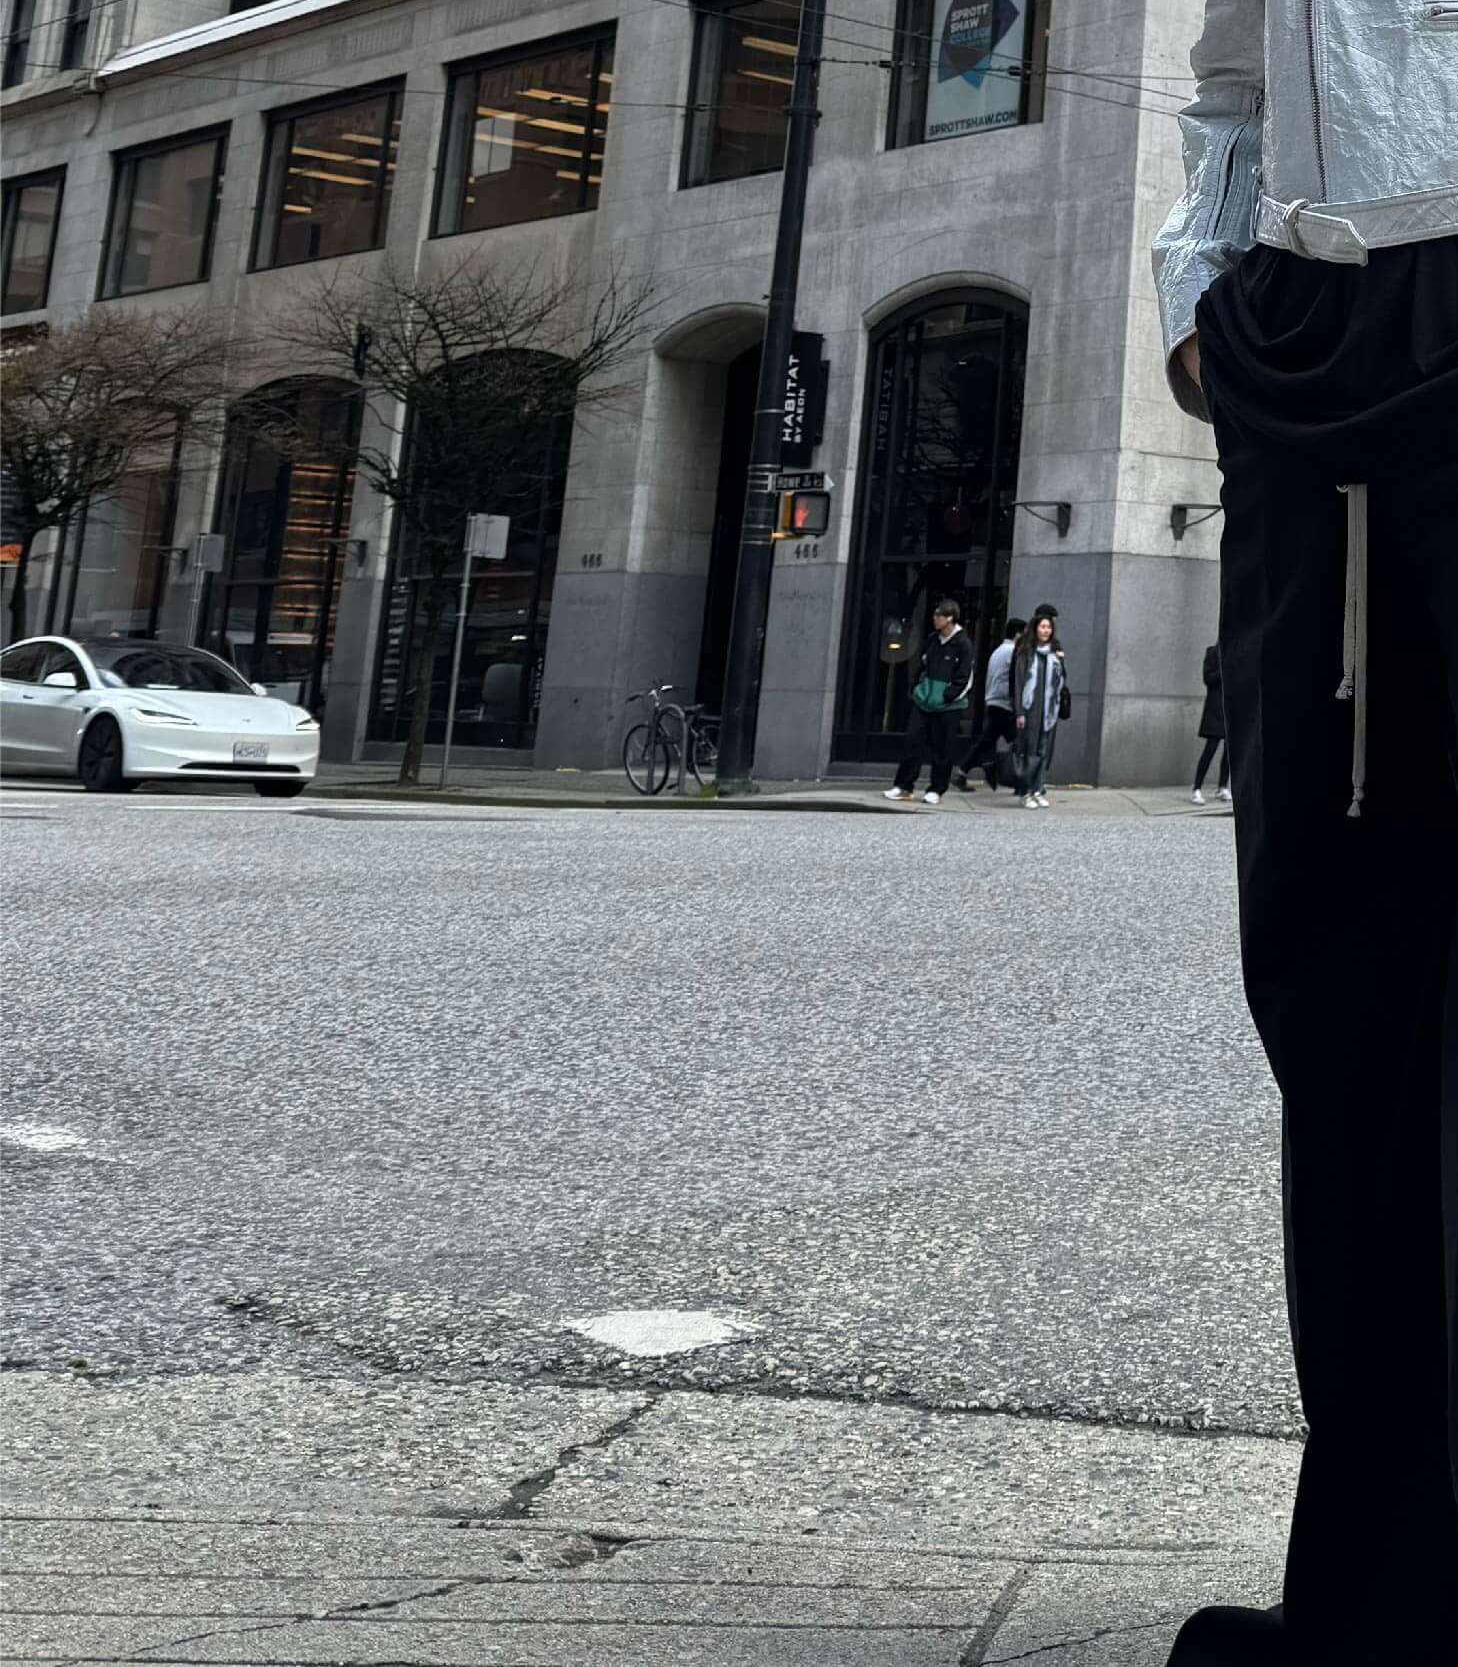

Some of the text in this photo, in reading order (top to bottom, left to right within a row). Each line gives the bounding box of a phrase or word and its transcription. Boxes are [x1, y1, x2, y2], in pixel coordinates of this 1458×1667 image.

[950, 17, 980, 33] SHAW
[929, 109, 1018, 136] SPROTTSHAW.COM
[782, 354, 800, 442] HABITAT
[794, 388, 806, 444] BY AEON
